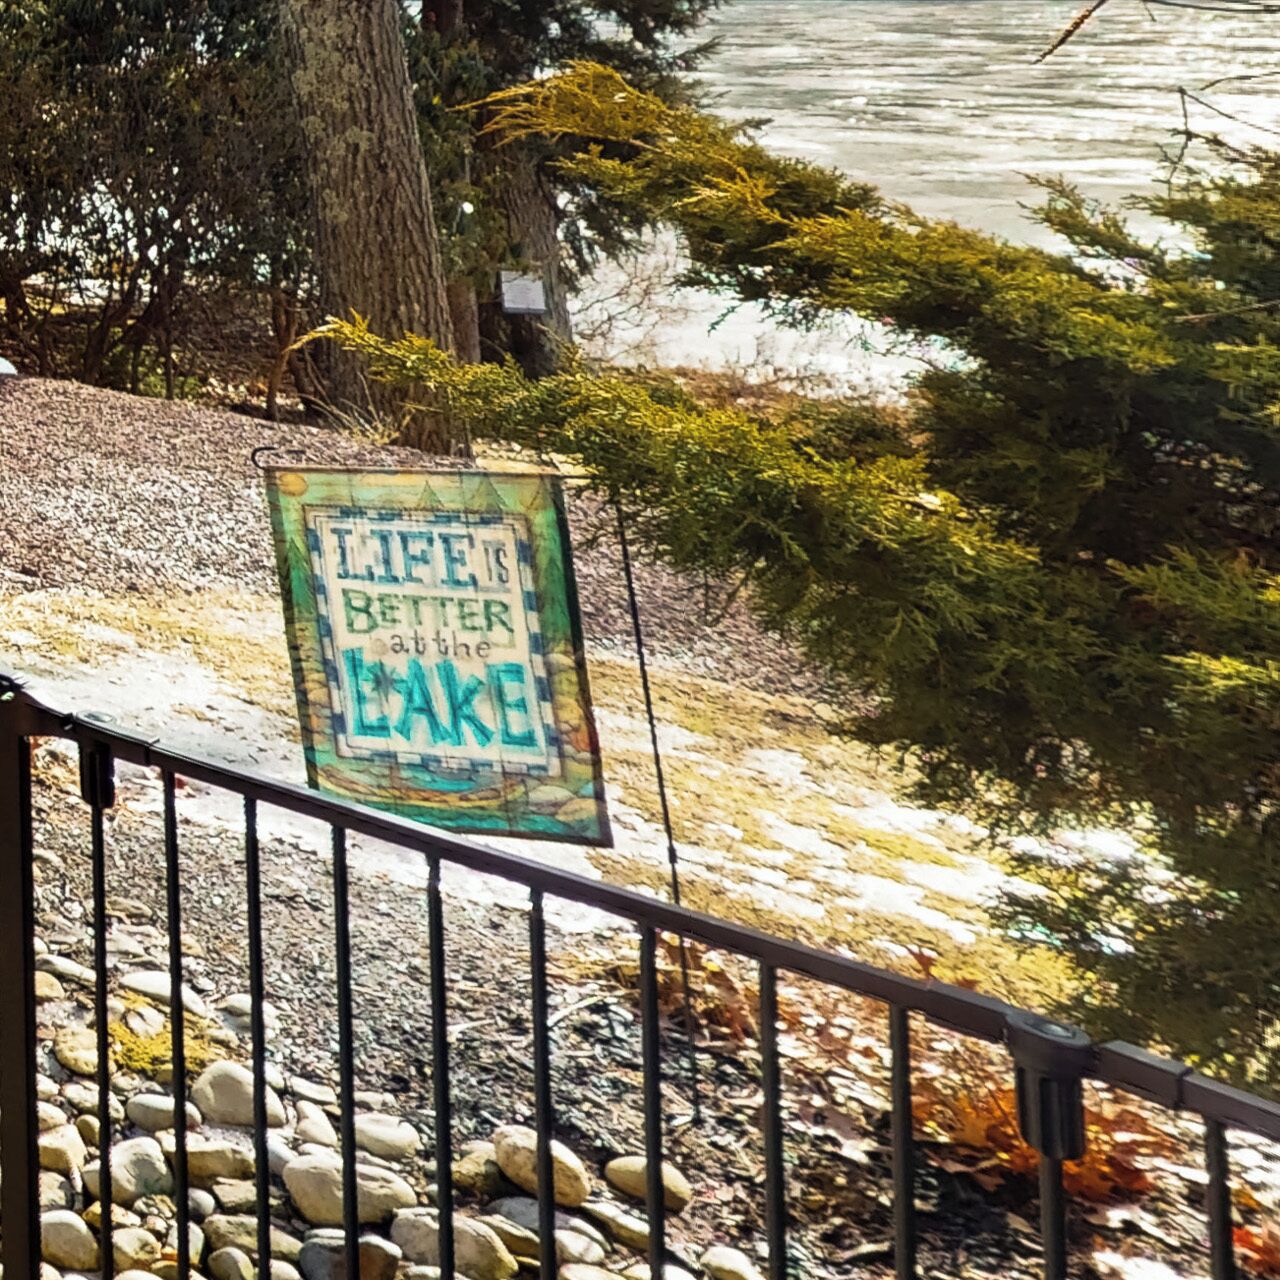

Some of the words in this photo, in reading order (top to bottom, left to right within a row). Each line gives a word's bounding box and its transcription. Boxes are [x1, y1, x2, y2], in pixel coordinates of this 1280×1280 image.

[331, 527, 479, 588] LIFE
[482, 542, 510, 587] IS
[342, 587, 515, 635] BETTER
[390, 630, 426, 656] at
[436, 631, 491, 659] the
[341, 646, 538, 749] LAKE
